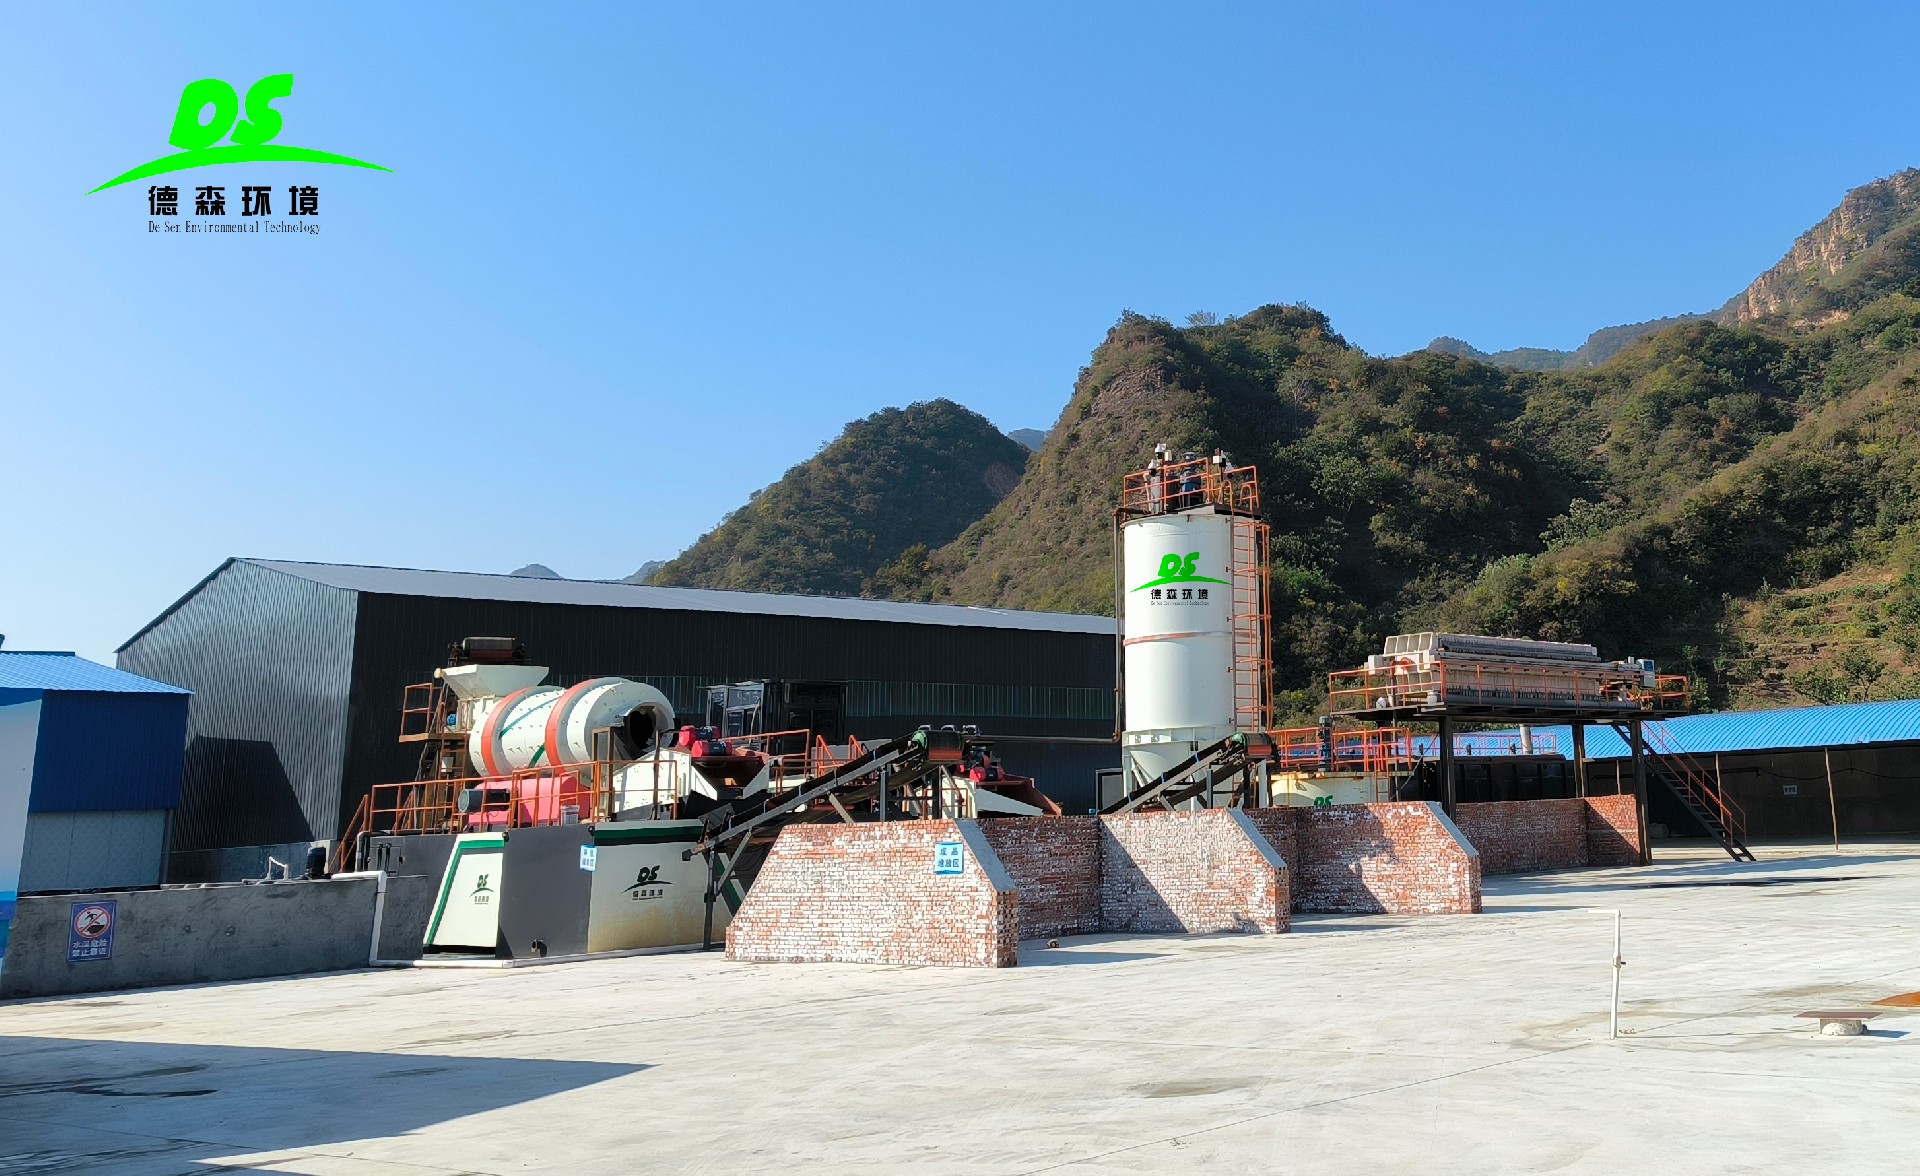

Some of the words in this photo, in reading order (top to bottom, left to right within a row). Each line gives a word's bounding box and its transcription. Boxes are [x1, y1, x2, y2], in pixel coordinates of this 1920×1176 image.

[1158, 551, 1200, 577] DS
[1151, 589, 1208, 600] 德森环境
[637, 865, 660, 882] DS
